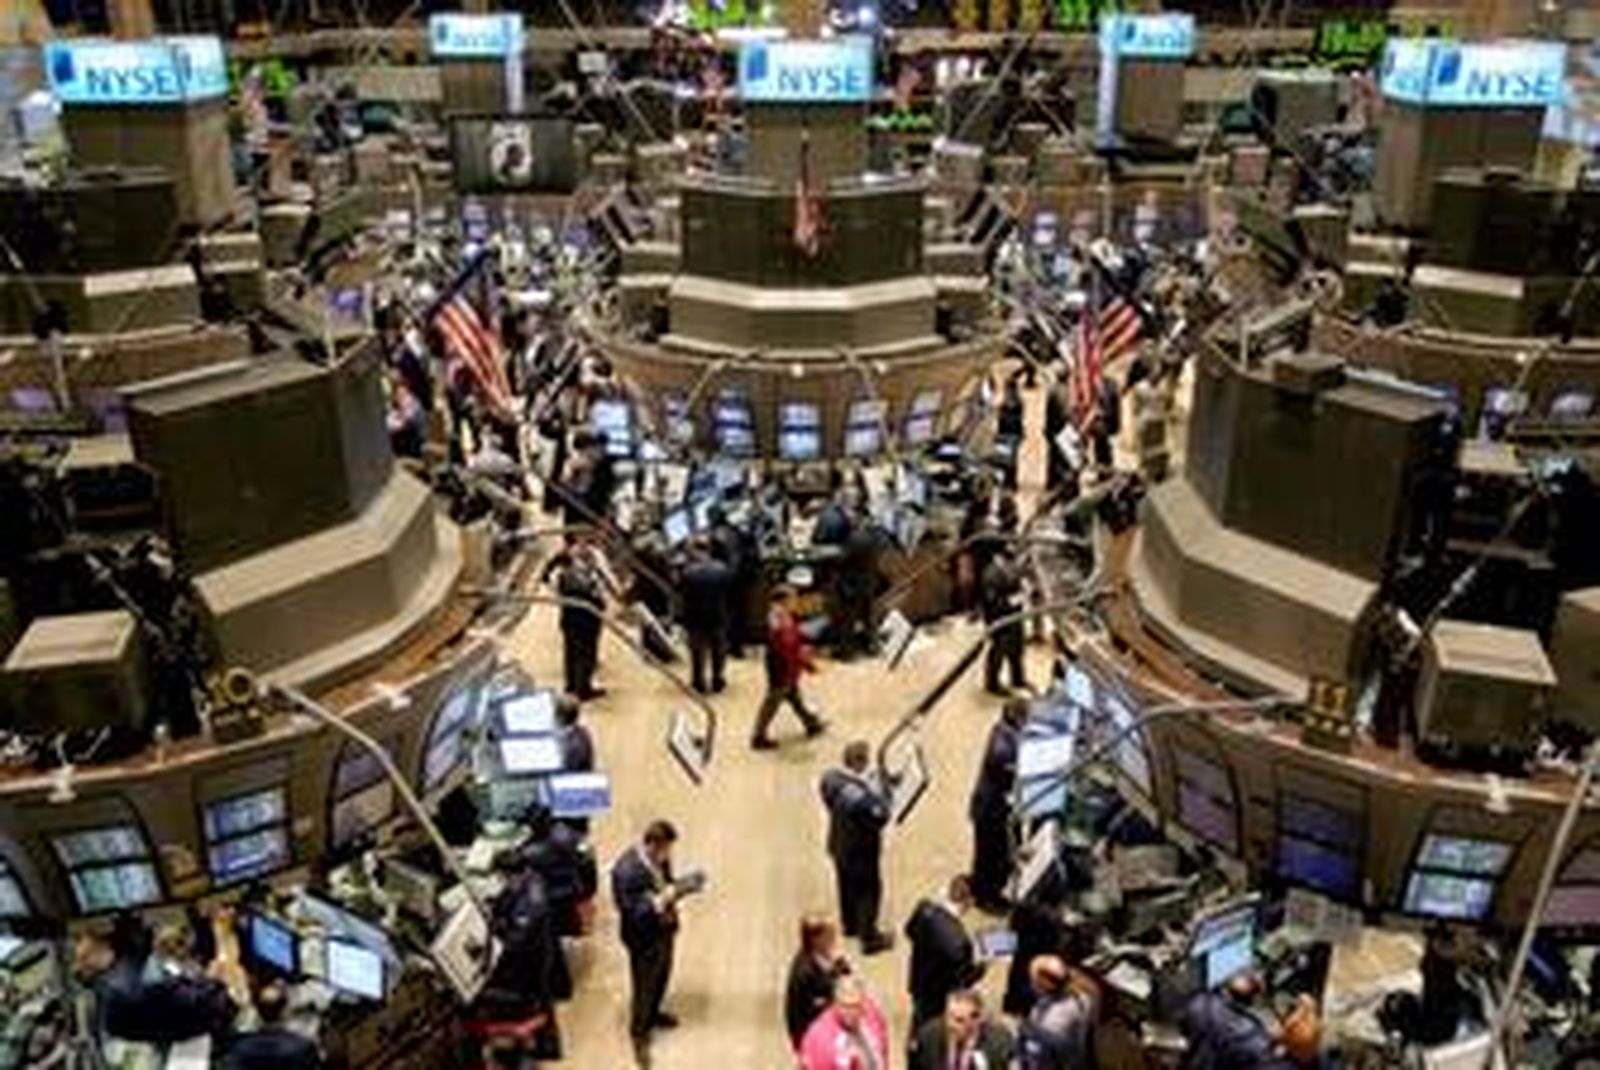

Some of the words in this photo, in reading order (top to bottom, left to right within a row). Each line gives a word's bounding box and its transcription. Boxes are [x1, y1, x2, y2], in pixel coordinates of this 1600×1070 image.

[85, 66, 173, 96] NYSE
[777, 65, 865, 95] NYSE
[1465, 68, 1551, 97] NYSE
